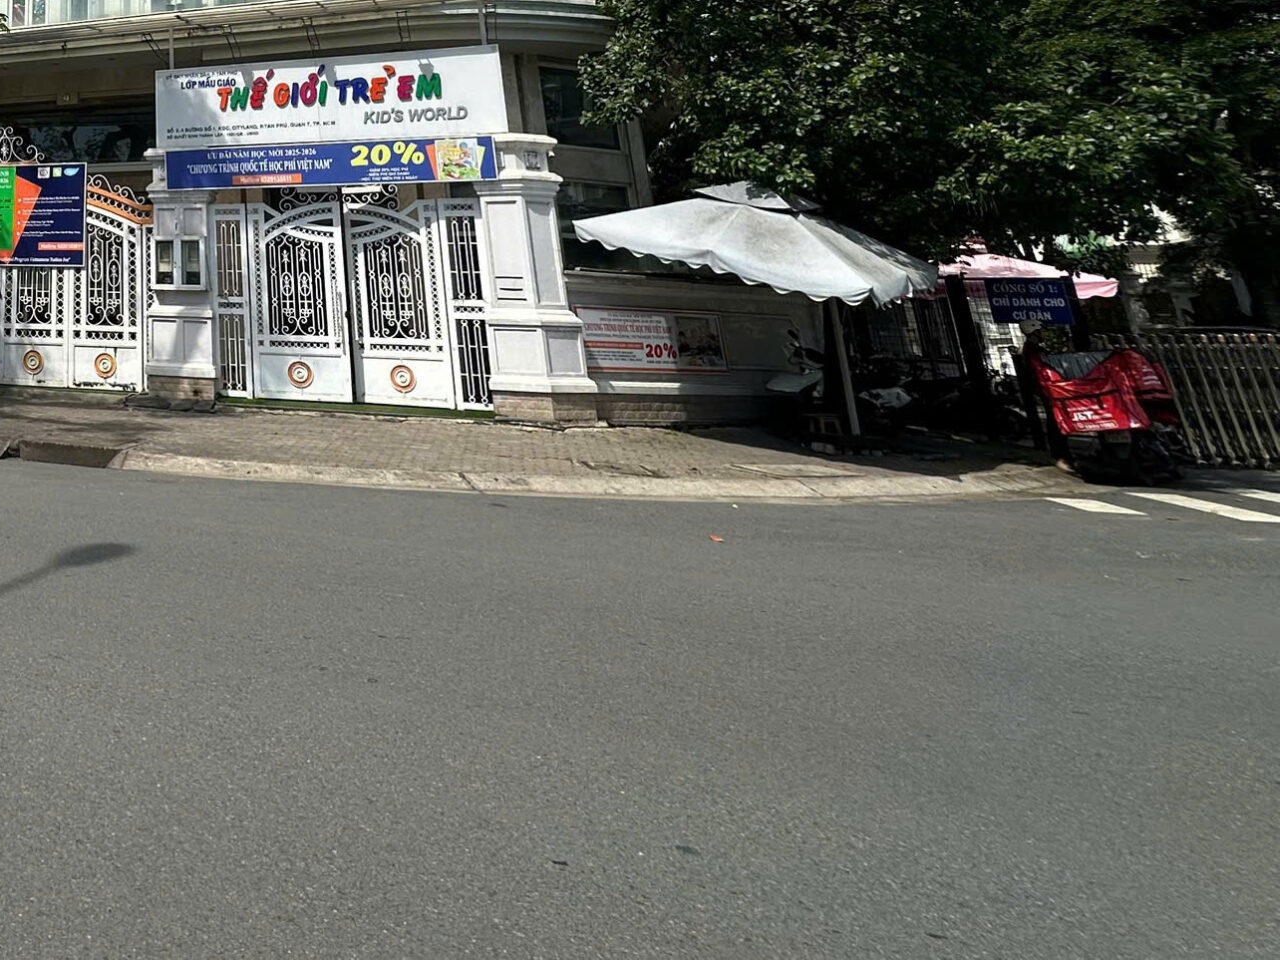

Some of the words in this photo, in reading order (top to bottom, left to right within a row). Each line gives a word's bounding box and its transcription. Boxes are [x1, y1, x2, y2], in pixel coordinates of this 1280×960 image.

[217, 77, 236, 87] GIÁO
[218, 69, 274, 111] THẾ
[274, 64, 327, 108] GIỚI
[335, 65, 396, 104] TRẺ
[398, 73, 442, 102] EM
[364, 107, 405, 124] KID'S
[408, 105, 469, 123] WORLD
[251, 149, 266, 160] HỌC
[284, 148, 317, 156] 2025-2026
[350, 141, 425, 166] 20%
[1043, 298, 1065, 307] CHO
[645, 342, 677, 359] 20%
